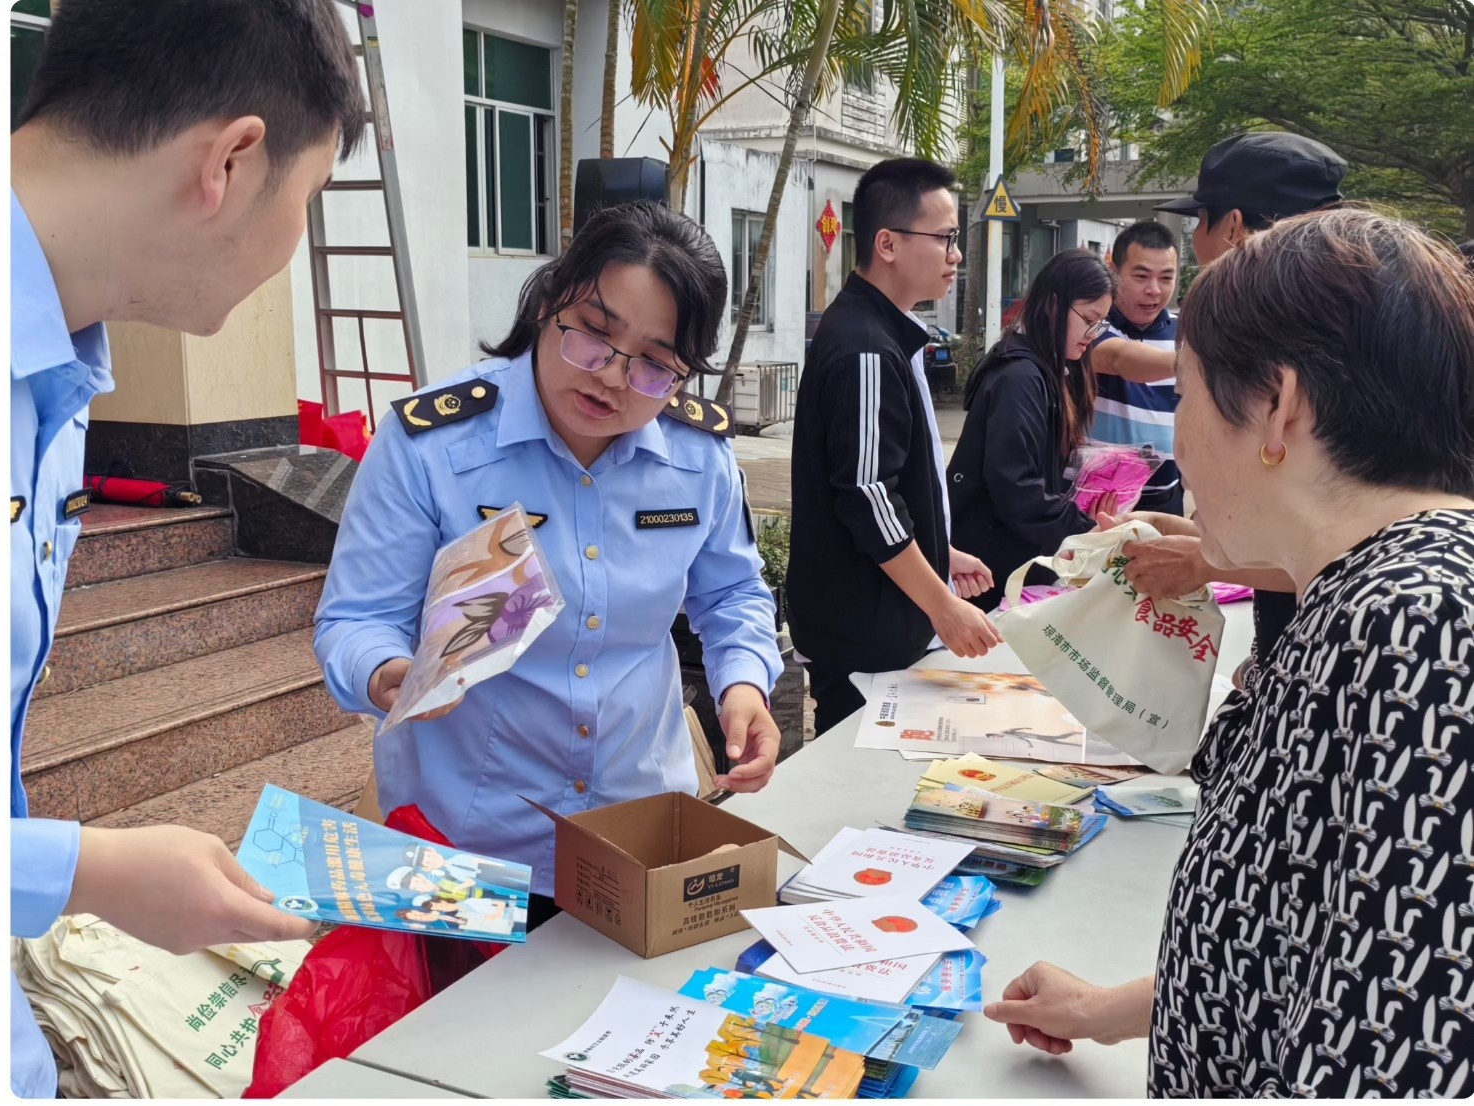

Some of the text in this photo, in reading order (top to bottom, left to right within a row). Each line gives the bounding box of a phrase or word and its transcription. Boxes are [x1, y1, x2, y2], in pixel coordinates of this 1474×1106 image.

[994, 195, 1008, 213] 慢
[1134, 596, 1219, 663] 食品安全
